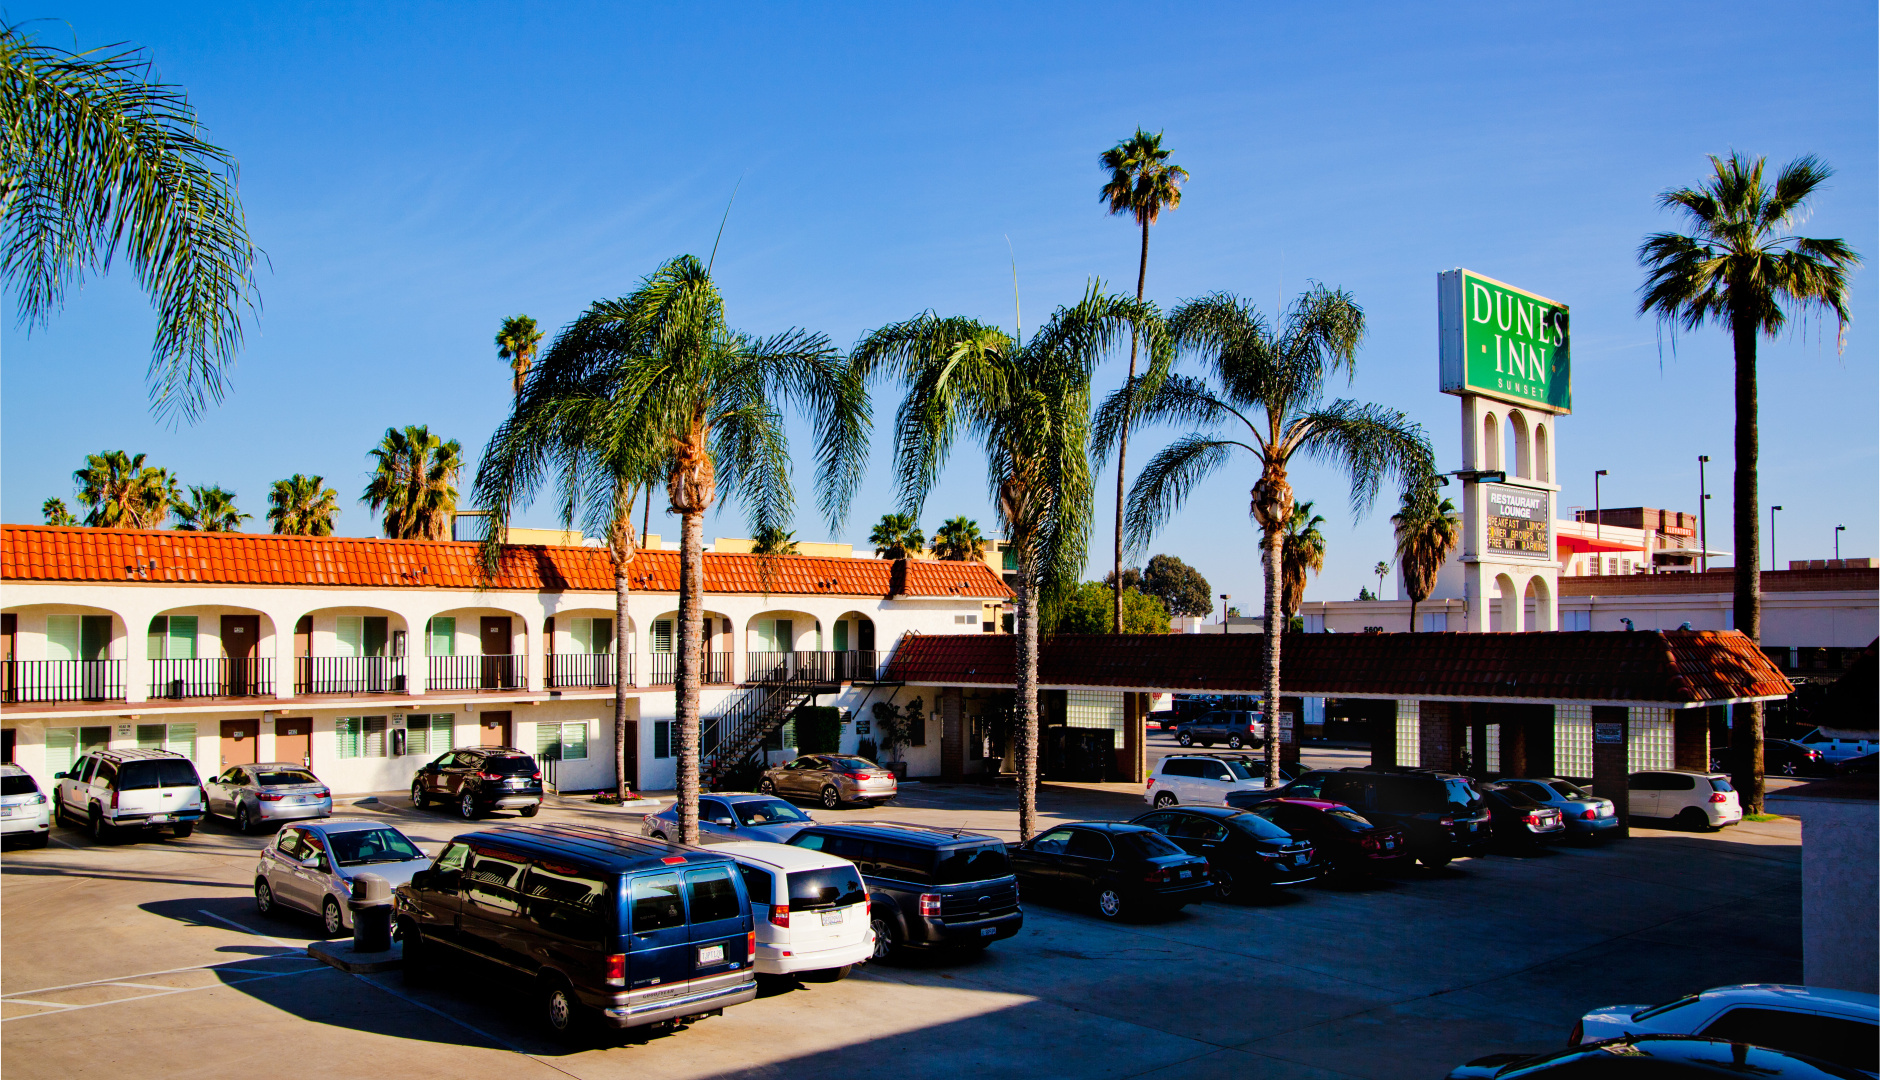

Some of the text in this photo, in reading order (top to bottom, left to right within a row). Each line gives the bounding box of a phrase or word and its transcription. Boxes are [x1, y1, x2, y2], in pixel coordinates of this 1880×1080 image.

[1471, 282, 1563, 347] DUNES
[1495, 334, 1545, 384] INN
[1498, 378, 1544, 398] SUNSET
[1490, 493, 1540, 509] RESTAURANT
[1500, 505, 1531, 518] LOUNGE
[1488, 515, 1546, 531] BREAKFAST LUNCH
[1666, 526, 1692, 536] ELEVATORS
[1510, 530, 1534, 541] GROUPS
[1537, 532, 1546, 541] OK
[1488, 538, 1502, 548] FREE
[1521, 541, 1547, 552] PARKING
